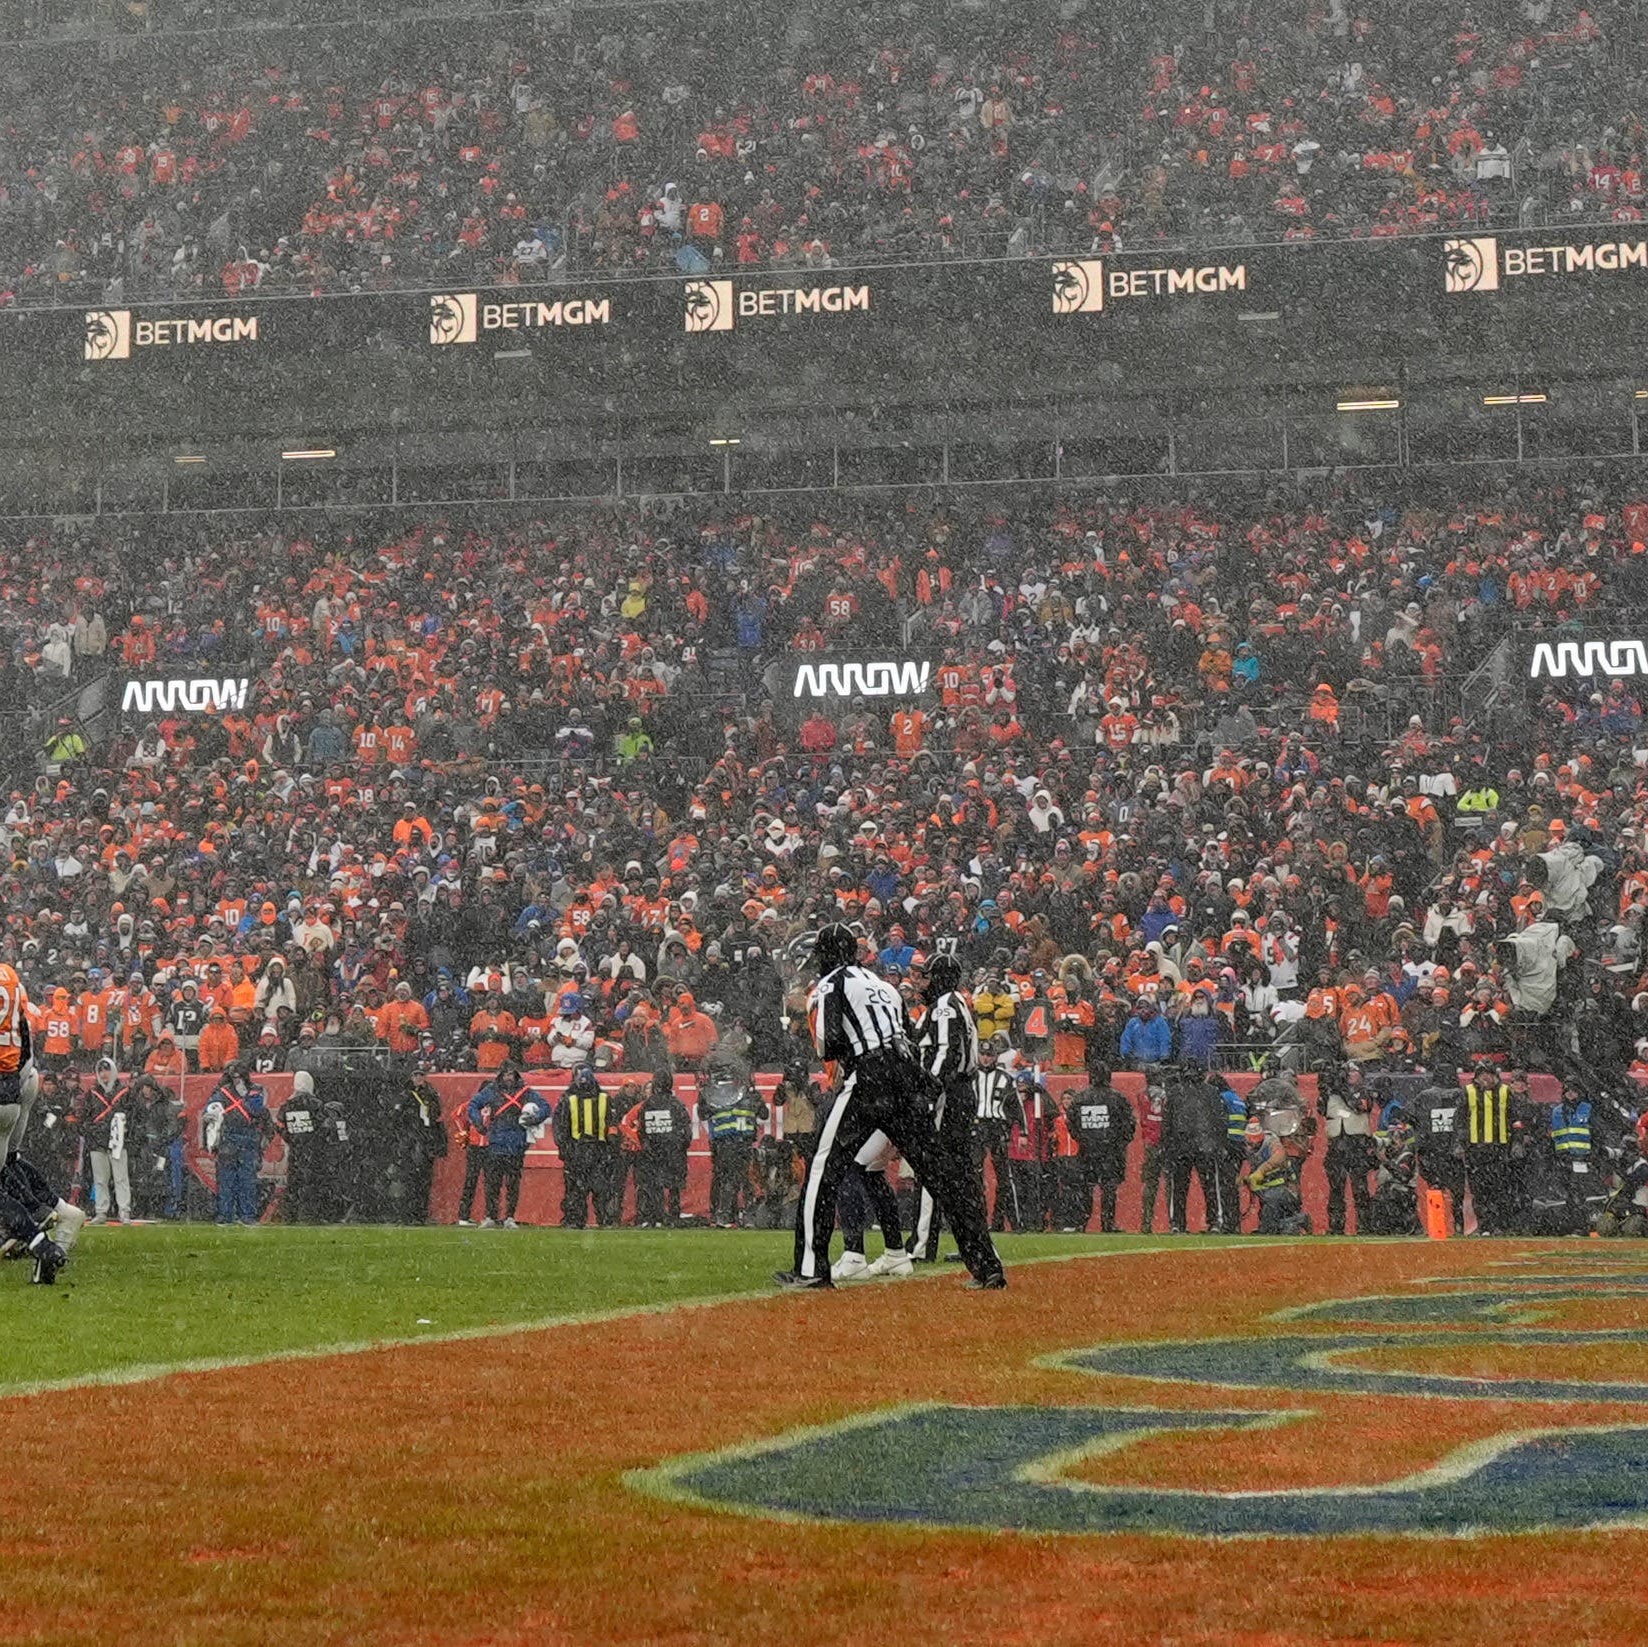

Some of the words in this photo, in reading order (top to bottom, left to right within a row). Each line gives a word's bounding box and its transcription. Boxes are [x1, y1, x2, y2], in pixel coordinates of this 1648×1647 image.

[1593, 175, 1611, 192] 14
[699, 209, 709, 222] 2
[1505, 241, 1648, 275] BETMGM
[1109, 265, 1245, 296] BETMGM
[739, 285, 870, 316] BETMGM
[483, 300, 609, 328] BETMGM
[136, 316, 258, 346] BETMGM
[1574, 582, 1587, 597] 10
[830, 601, 850, 616] 58
[266, 618, 279, 632] 10
[793, 661, 930, 698] ARROW
[943, 672, 959, 689] 10
[122, 679, 248, 712] ARROW
[902, 718, 913, 735] 2
[1108, 723, 1127, 739] 15
[360, 732, 376, 747] 10
[391, 735, 405, 750] 14
[1118, 806, 1128, 822] 0
[225, 909, 240, 926] 10
[48, 950, 57, 963] 2
[88, 1005, 99, 1024] 8
[1025, 1006, 1047, 1036] 4
[47, 1021, 69, 1038] 58
[1347, 1017, 1371, 1034] 24
